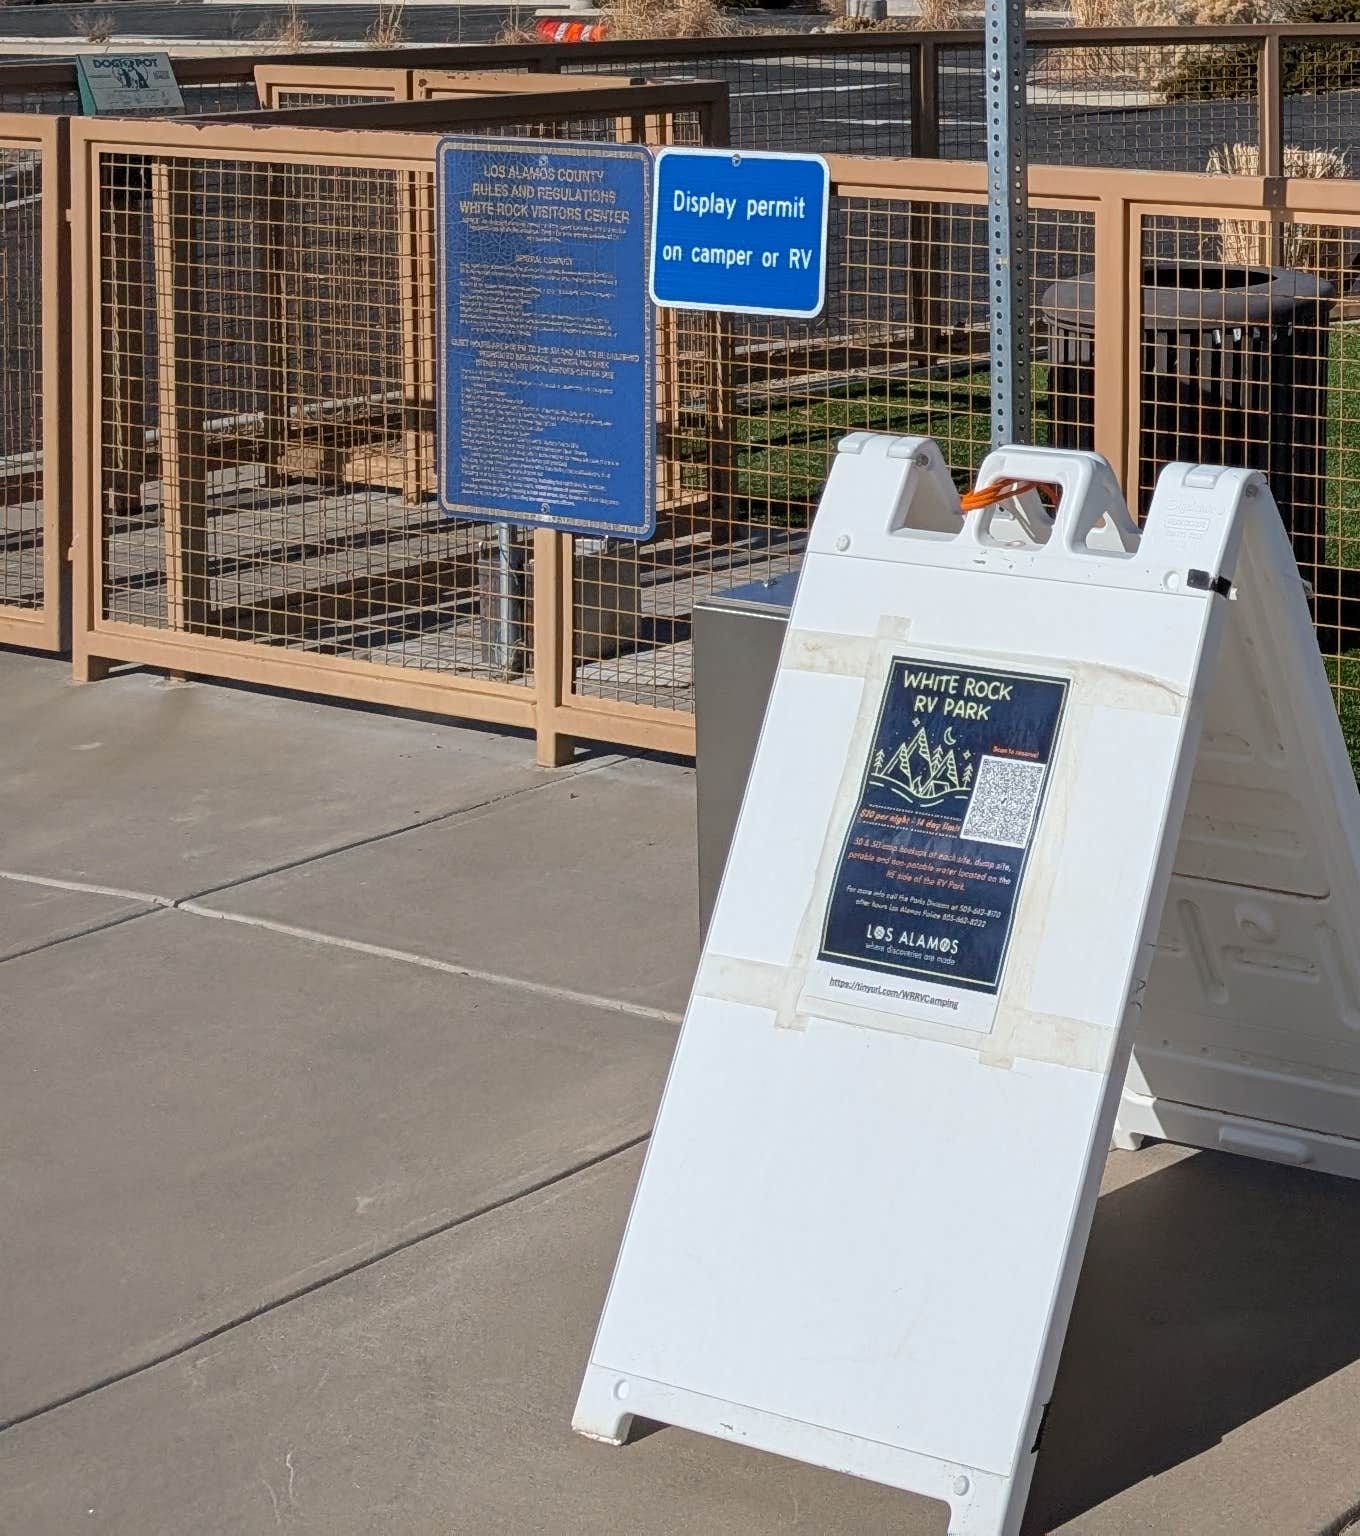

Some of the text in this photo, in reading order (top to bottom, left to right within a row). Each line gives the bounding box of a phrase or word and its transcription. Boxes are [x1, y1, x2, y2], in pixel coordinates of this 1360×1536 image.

[484, 165, 605, 184] LOS ALAMOS COUNTY
[473, 183, 616, 204] RULES AND REGULATIONS
[460, 201, 630, 225] WHITE ROCK VISITORS CENTER
[674, 190, 806, 221] Display permit
[663, 245, 812, 270] on camper or RV
[904, 670, 1014, 701] WHITE ROCK
[914, 695, 992, 721] RV PARK
[875, 813, 890, 821] per
[889, 815, 911, 825] night
[926, 820, 942, 831] day
[939, 853, 956, 862] each
[914, 875, 924, 883] of
[937, 879, 948, 887] RV
[936, 867, 958, 876] water
[958, 869, 988, 881] located
[999, 876, 1012, 885] the
[867, 924, 959, 955] LOS ALAMOS
[887, 945, 922, 960] discoveries
[924, 953, 935, 962] are
[937, 956, 956, 966] made
